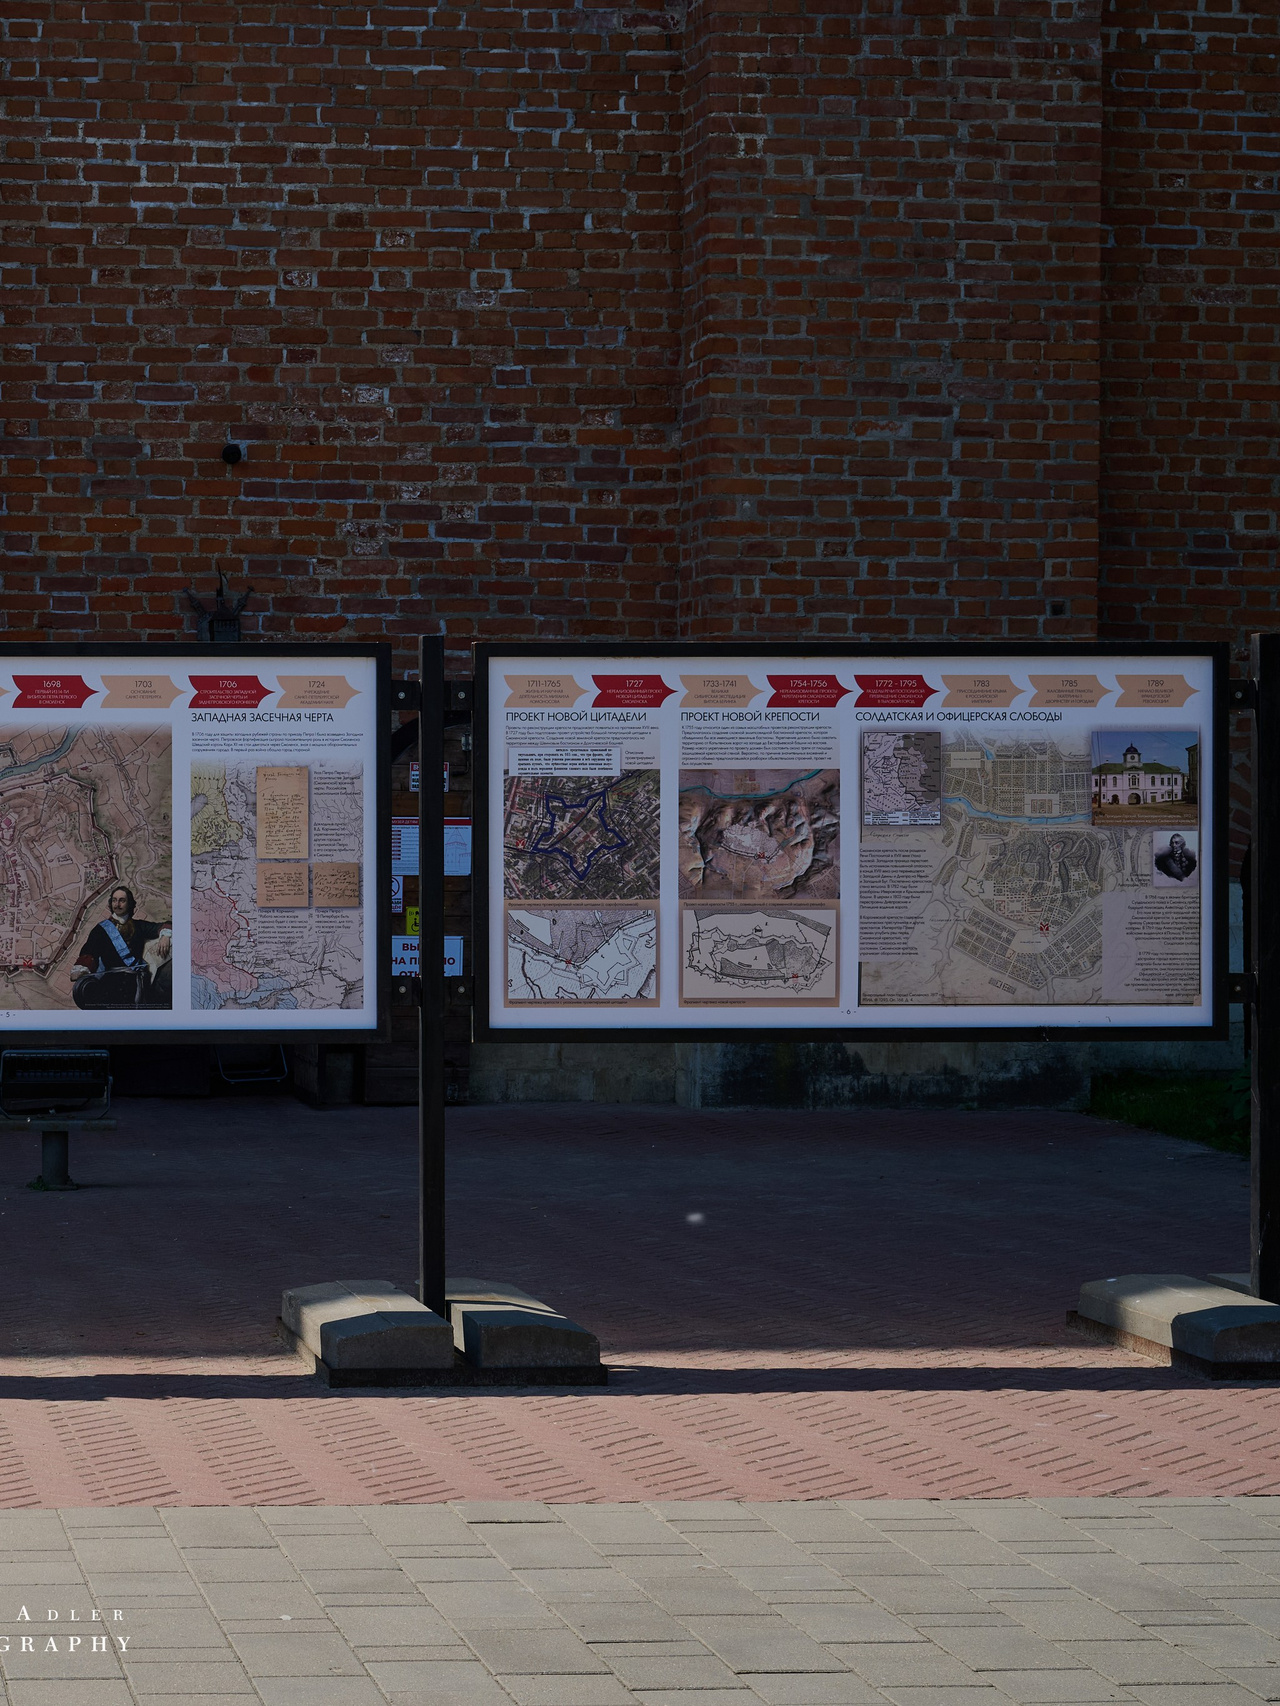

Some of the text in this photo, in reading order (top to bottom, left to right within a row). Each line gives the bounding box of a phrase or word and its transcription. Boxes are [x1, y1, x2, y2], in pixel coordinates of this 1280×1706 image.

[43, 680, 62, 688] 1698
[135, 680, 153, 688] 1703
[219, 680, 238, 688] 1706
[309, 680, 326, 688] 1724
[527, 679, 561, 687] 1711-1765
[625, 679, 644, 687] 1727
[703, 679, 737, 687] 1733-1741
[790, 679, 827, 687] 1754-1756
[875, 679, 917, 687] 1772 1795
[972, 679, 990, 687] 1783
[1061, 679, 1078, 687] 1785
[1147, 679, 1165, 687] 1789
[191, 713, 334, 723] ЗАПАДНАЯ ЗАСЕЧНАЯ ЧЕРТА
[505, 710, 647, 723] ПРОЕКТ НОВОЙ ЦИТАДЕЛИ
[680, 710, 820, 722] ПРОЕКТ НОВОЙ КРЕПОСТИ
[855, 712, 1063, 723] СОЛДАТСКАЯ И ОФИЦЕРСКАЯ СЛОБОДЫ
